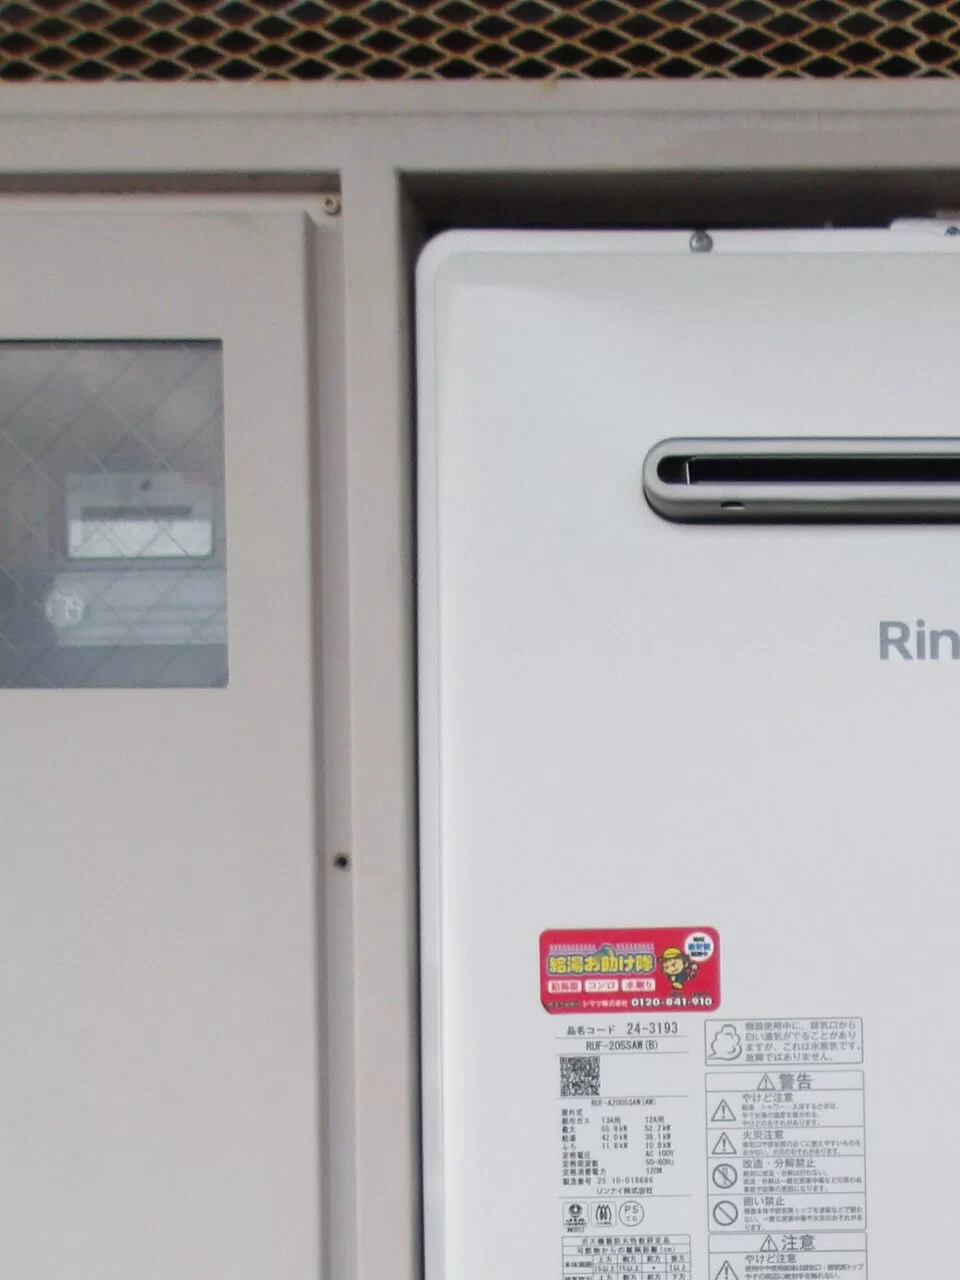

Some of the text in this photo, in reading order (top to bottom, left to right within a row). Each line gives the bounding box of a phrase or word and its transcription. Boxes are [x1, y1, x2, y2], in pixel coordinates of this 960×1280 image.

[549, 954, 654, 974] 給湯お助け隊
[631, 997, 713, 1007] 0120-841-910
[567, 1022, 678, 1036] 品名コード 24-3193
[779, 1073, 813, 1091] 警告
[742, 1093, 794, 1103] やけど注意
[743, 1158, 816, 1169] 改造・分解禁止
[782, 1234, 816, 1251] 注意
[745, 1254, 797, 1264] やけど注意
